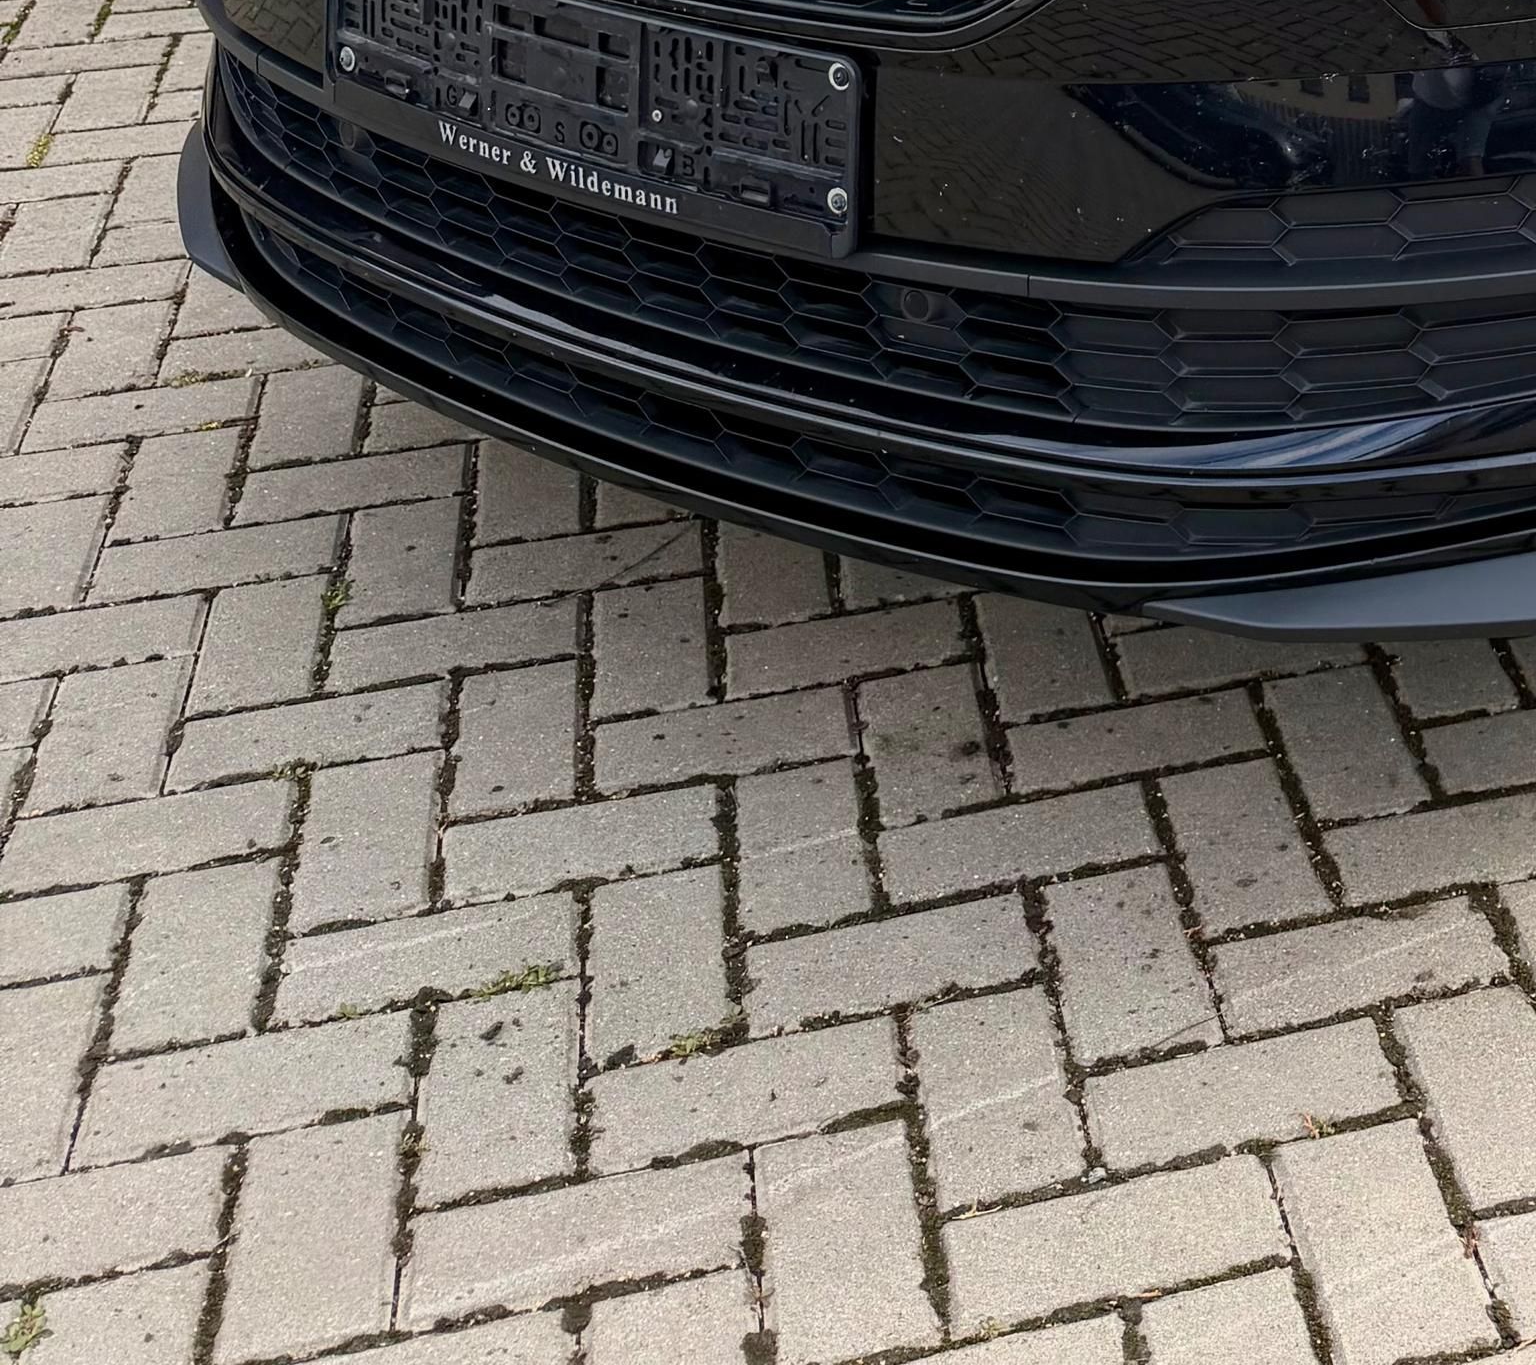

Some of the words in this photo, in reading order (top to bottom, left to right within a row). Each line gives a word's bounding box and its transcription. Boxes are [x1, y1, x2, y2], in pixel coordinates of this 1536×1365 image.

[438, 119, 511, 165] Werner
[519, 150, 538, 174] &
[546, 156, 679, 215] Wildemann
